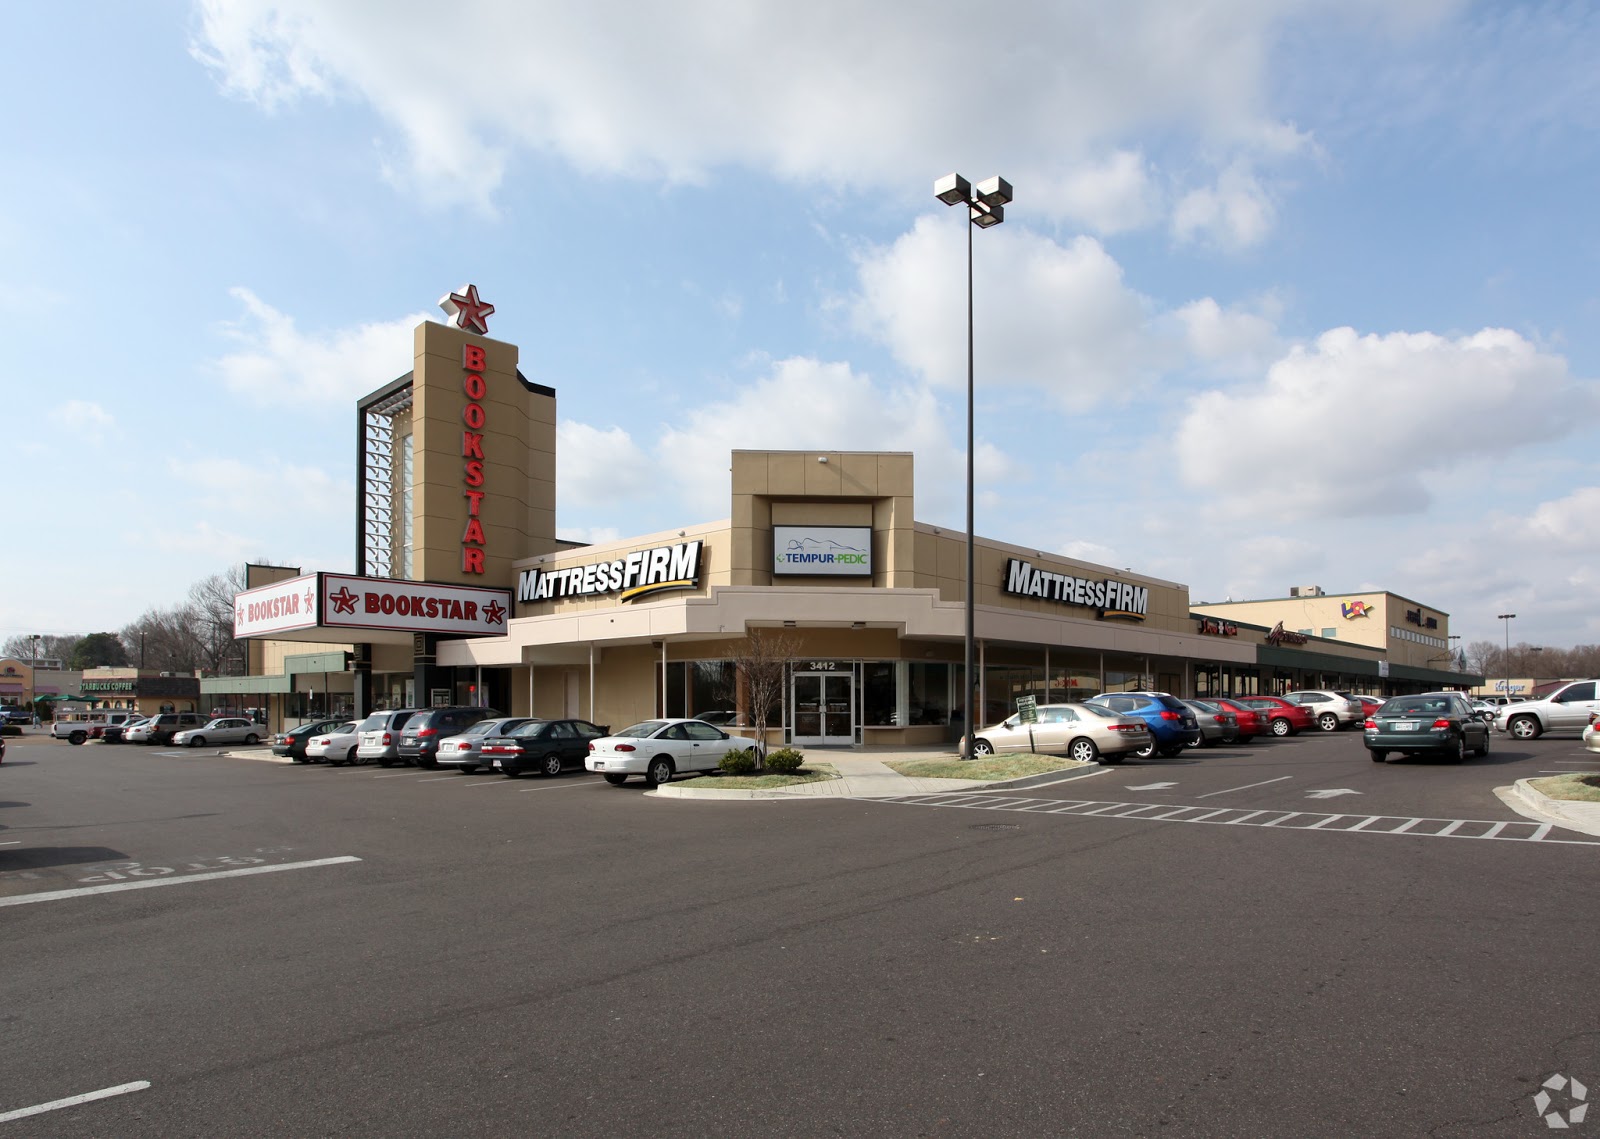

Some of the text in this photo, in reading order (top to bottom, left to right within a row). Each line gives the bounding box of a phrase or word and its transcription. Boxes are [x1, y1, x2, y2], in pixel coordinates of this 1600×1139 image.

[462, 343, 487, 574] BOOKSTAR
[786, 553, 868, 564] TEMPUR-PEDIC
[248, 592, 300, 623] BOOKSTAR
[364, 592, 478, 621] BOOKSTAR
[809, 660, 836, 671] 3412
[79, 682, 132, 691] STARBUCKS COFFEE
